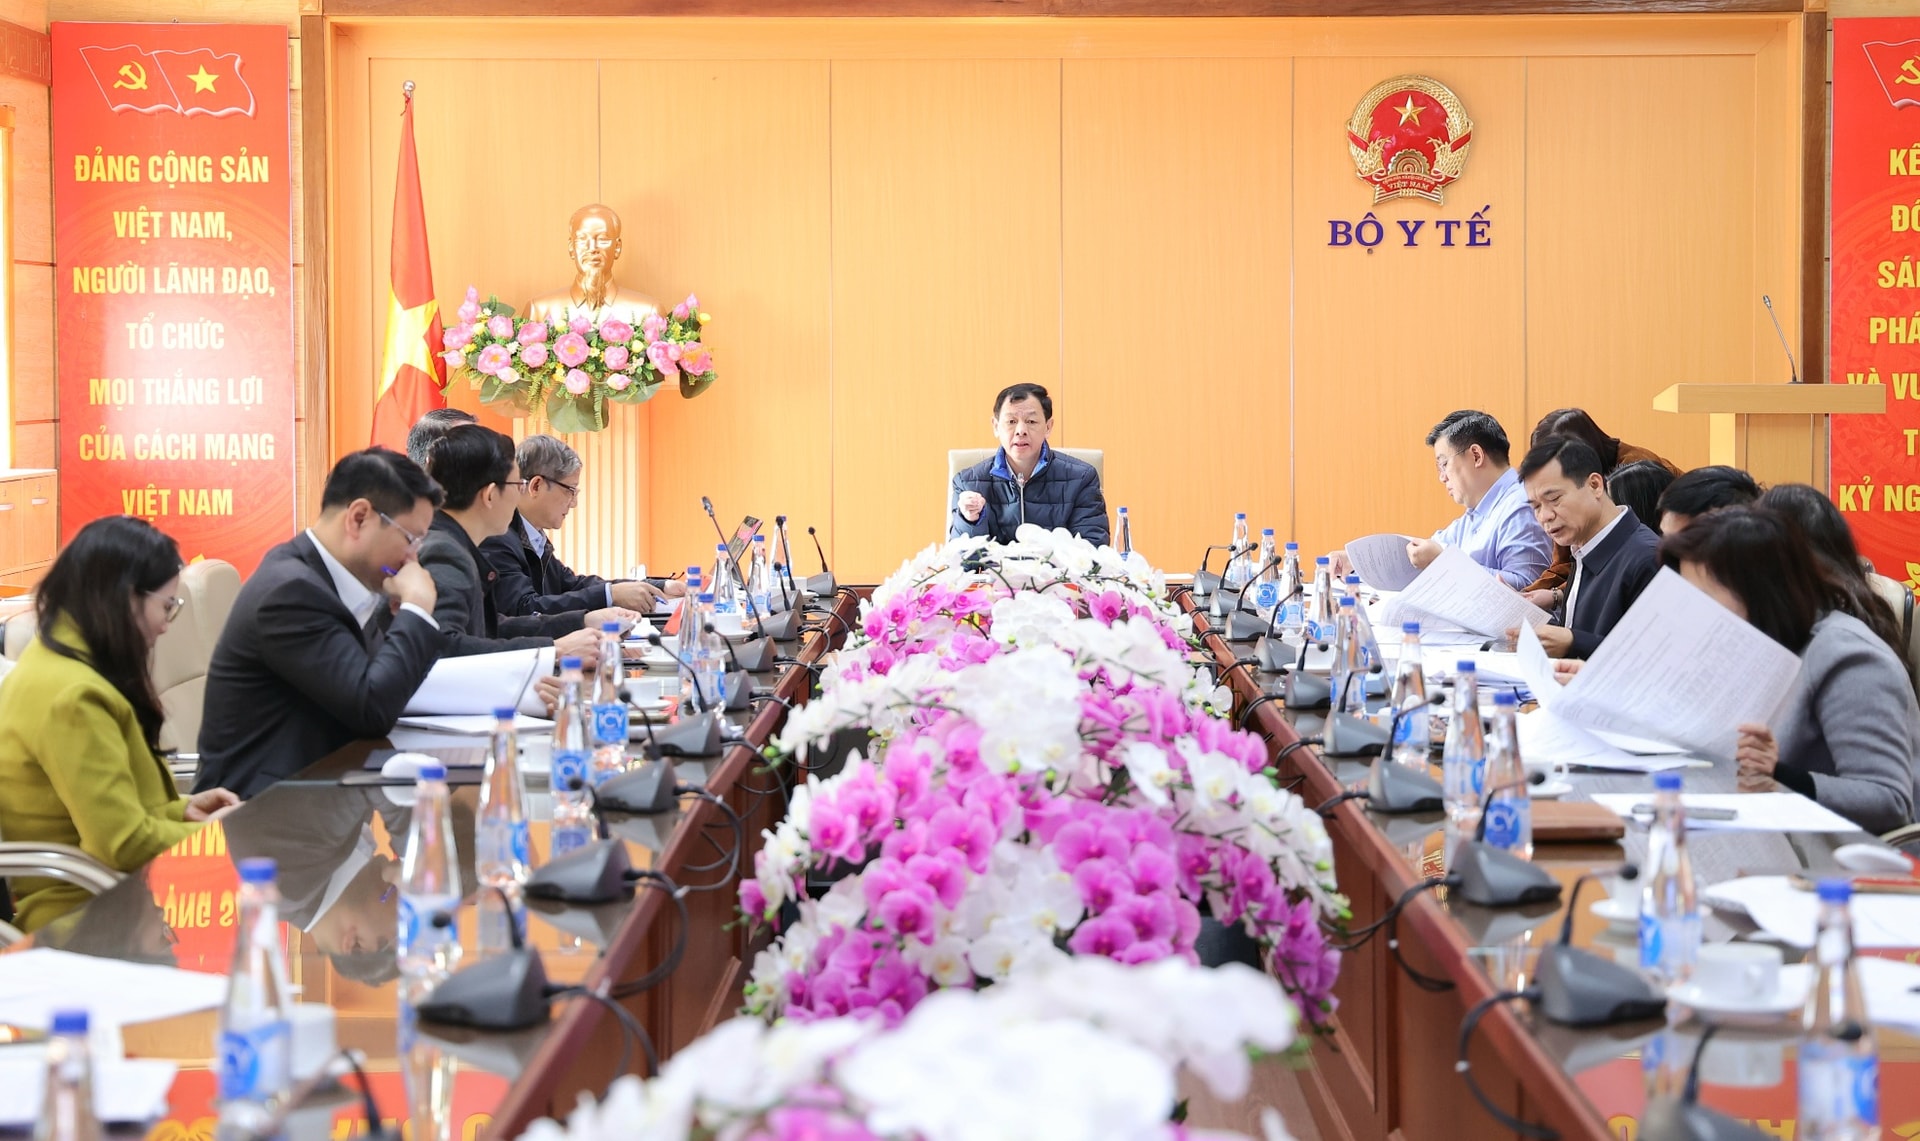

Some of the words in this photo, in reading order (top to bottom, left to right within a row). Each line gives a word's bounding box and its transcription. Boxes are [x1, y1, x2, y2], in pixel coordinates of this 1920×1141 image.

[74, 146, 140, 182] ĐẢNG
[148, 150, 213, 189] CỘNG
[220, 147, 269, 183] SẢN
[113, 205, 163, 245] VIỆT
[170, 211, 233, 242] NAM,
[1328, 212, 1384, 255] BỘ
[1396, 220, 1425, 247] Y
[1436, 205, 1491, 247] TẾ
[73, 260, 145, 294] NGƯỜI
[153, 262, 215, 294] LÃNH
[222, 266, 275, 300] ĐẠO,
[1877, 255, 1920, 289] SÁ
[125, 312, 155, 350] TỔ
[162, 317, 225, 350] CHỨC
[89, 378, 134, 411] MỌI
[142, 368, 220, 405] THẮNG
[227, 375, 263, 410] LỢI
[79, 425, 127, 461] CỦA
[134, 428, 196, 460] CÁCH
[204, 433, 275, 467] MẠNG
[121, 483, 171, 522] VIỆT
[178, 488, 233, 516] NAM
[1839, 475, 1875, 511] KỶ
